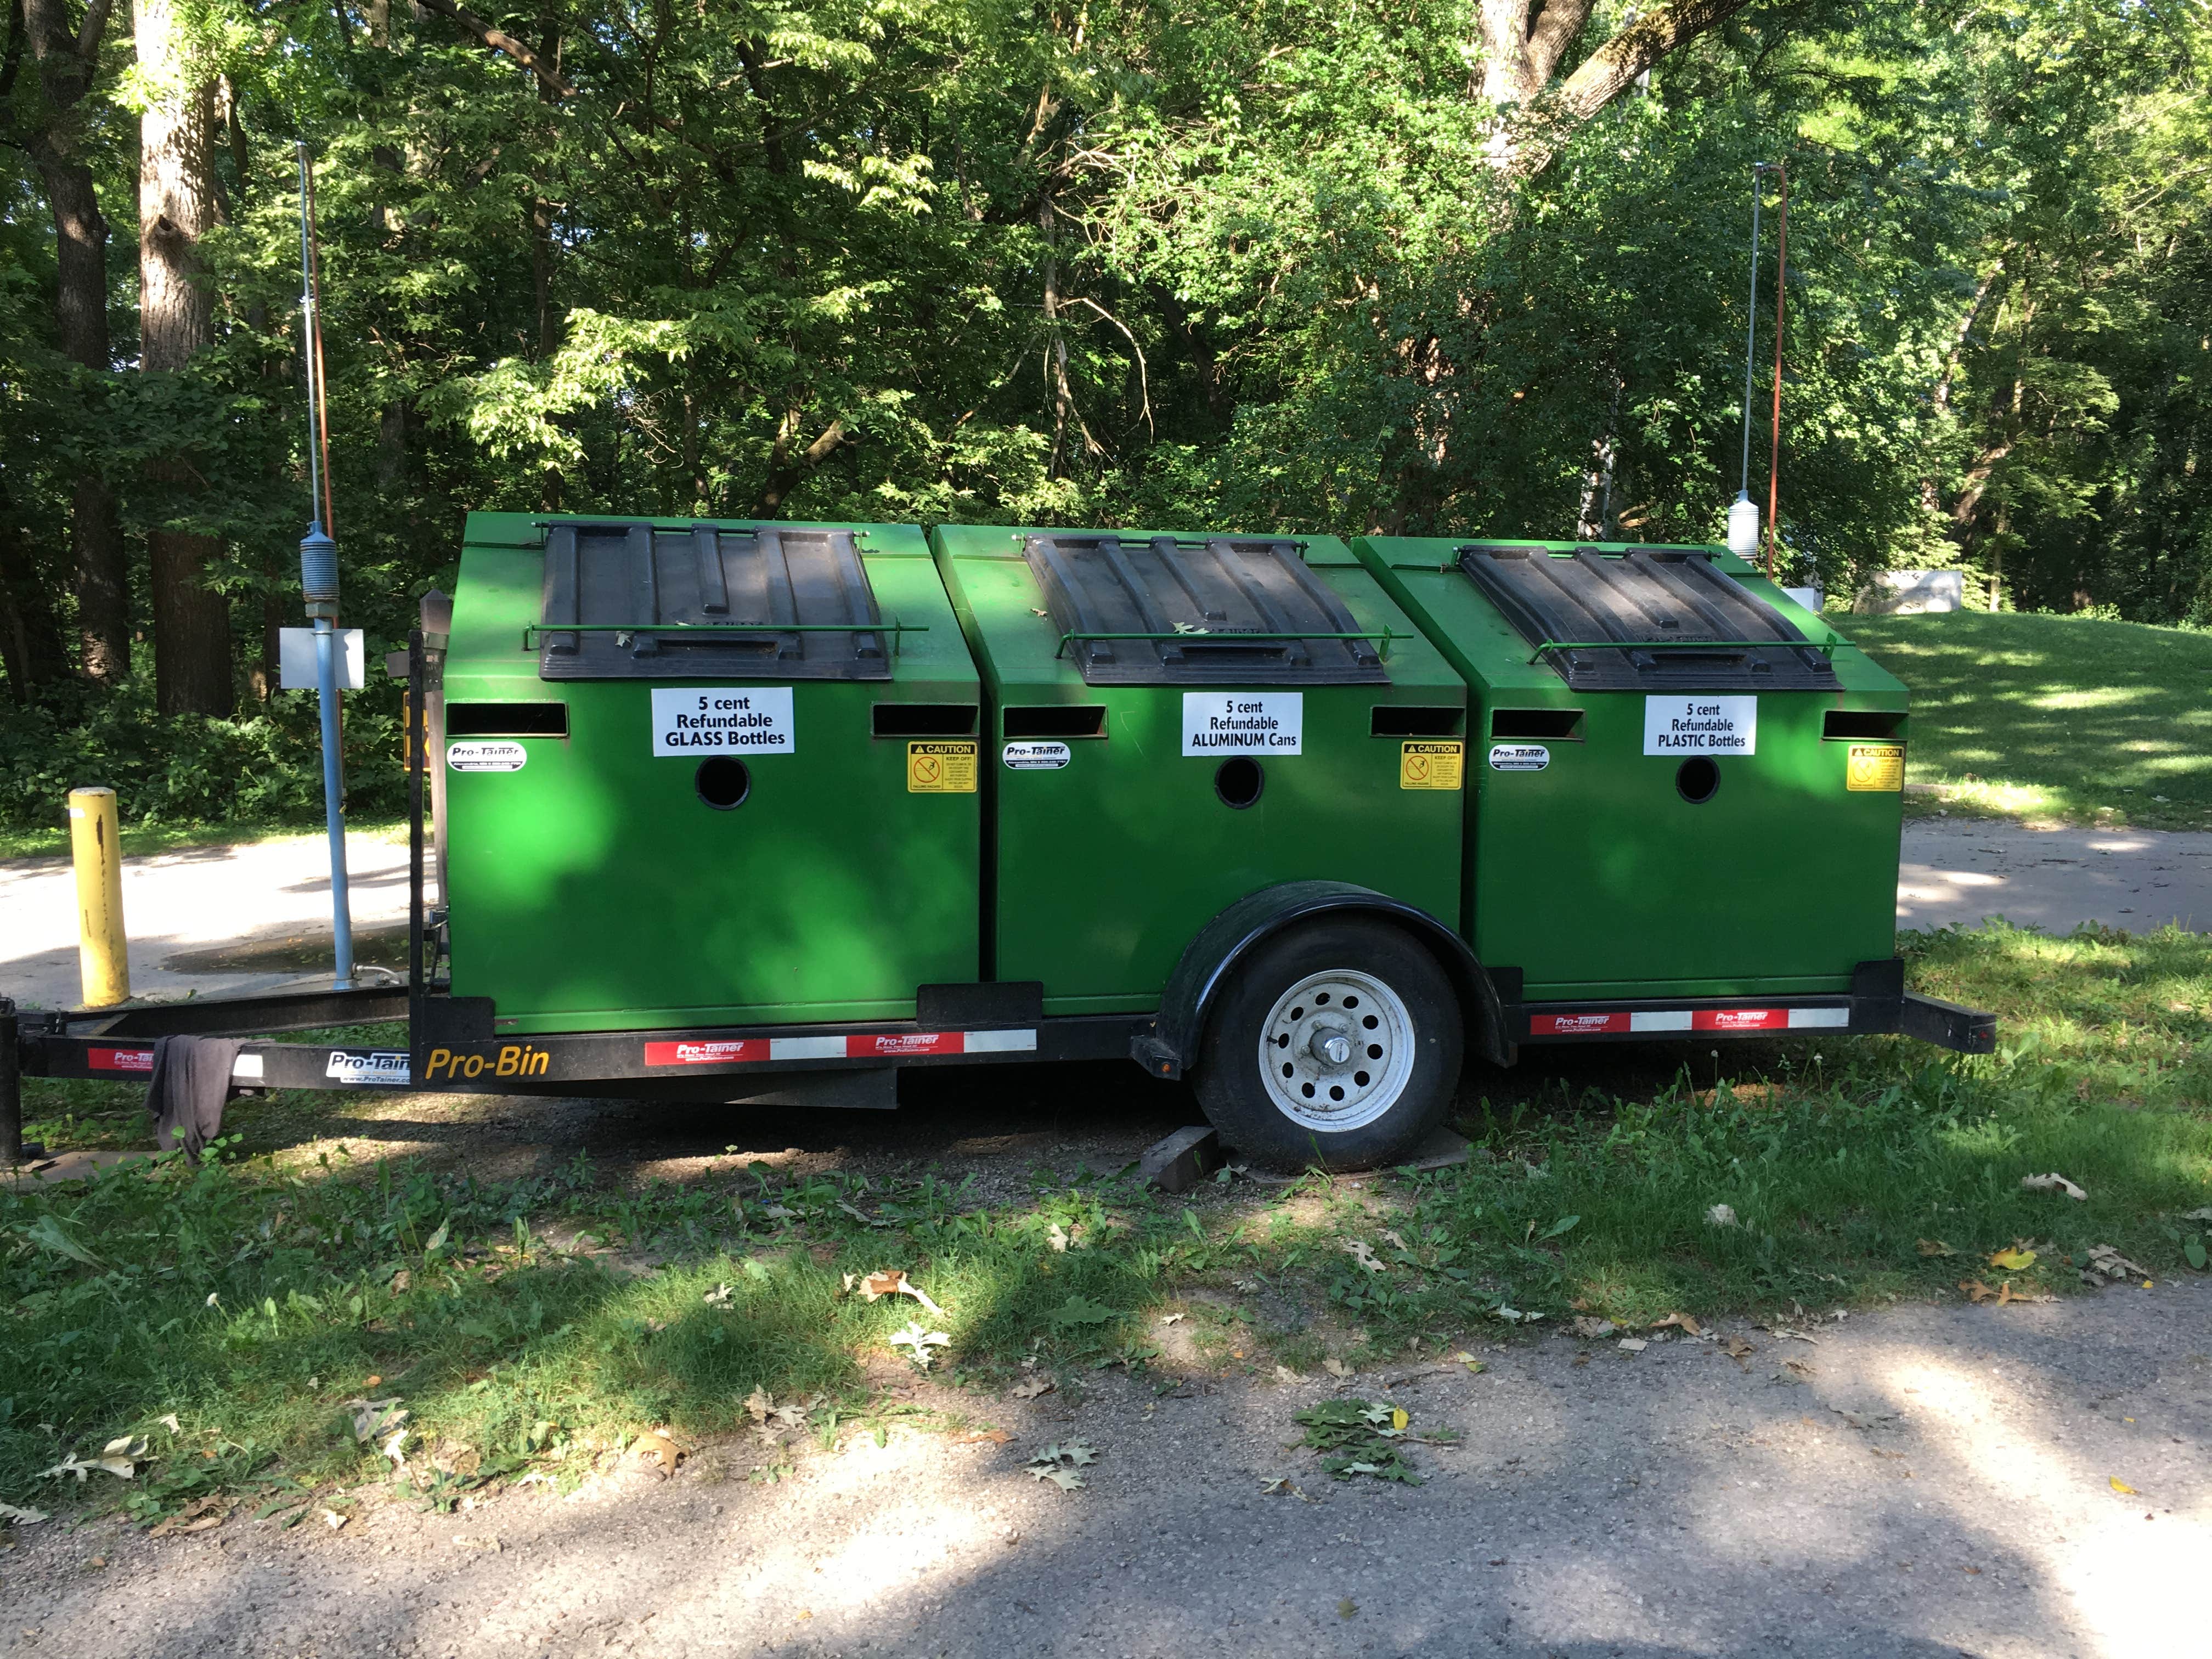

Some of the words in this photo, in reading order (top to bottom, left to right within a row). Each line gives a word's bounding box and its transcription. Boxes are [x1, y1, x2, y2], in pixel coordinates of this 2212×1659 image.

[699, 697, 708, 710] 5
[714, 697, 750, 710] cent
[1226, 700, 1233, 713] 5
[1238, 701, 1263, 713] cent
[1686, 703, 1693, 715] 5
[1697, 704, 1720, 715] cent
[677, 713, 773, 728] Refundable
[1210, 716, 1278, 730] Refundable
[1672, 719, 1734, 731] Refundable
[665, 731, 723, 746] GLASS
[728, 731, 785, 745] Bottles
[1192, 733, 1265, 747] ALUMINUM
[1269, 732, 1296, 746] Cans
[1658, 734, 1705, 747] PLASTIC
[1708, 734, 1746, 747] Bottles
[452, 747, 519, 755] Pro-Tainer
[1007, 746, 1065, 755] Pro-Tainer
[1555, 1016, 1610, 1025] Pro-Tainer
[1715, 1012, 1769, 1022] Pro-Tainer
[876, 1035, 940, 1046] Pro-Tainer
[676, 1042, 744, 1054] Pro-Tainer
[114, 1052, 154, 1062] Pro-Tai
[331, 1054, 410, 1070] Pro-Tain
[425, 1045, 549, 1079] Pro-Bin
